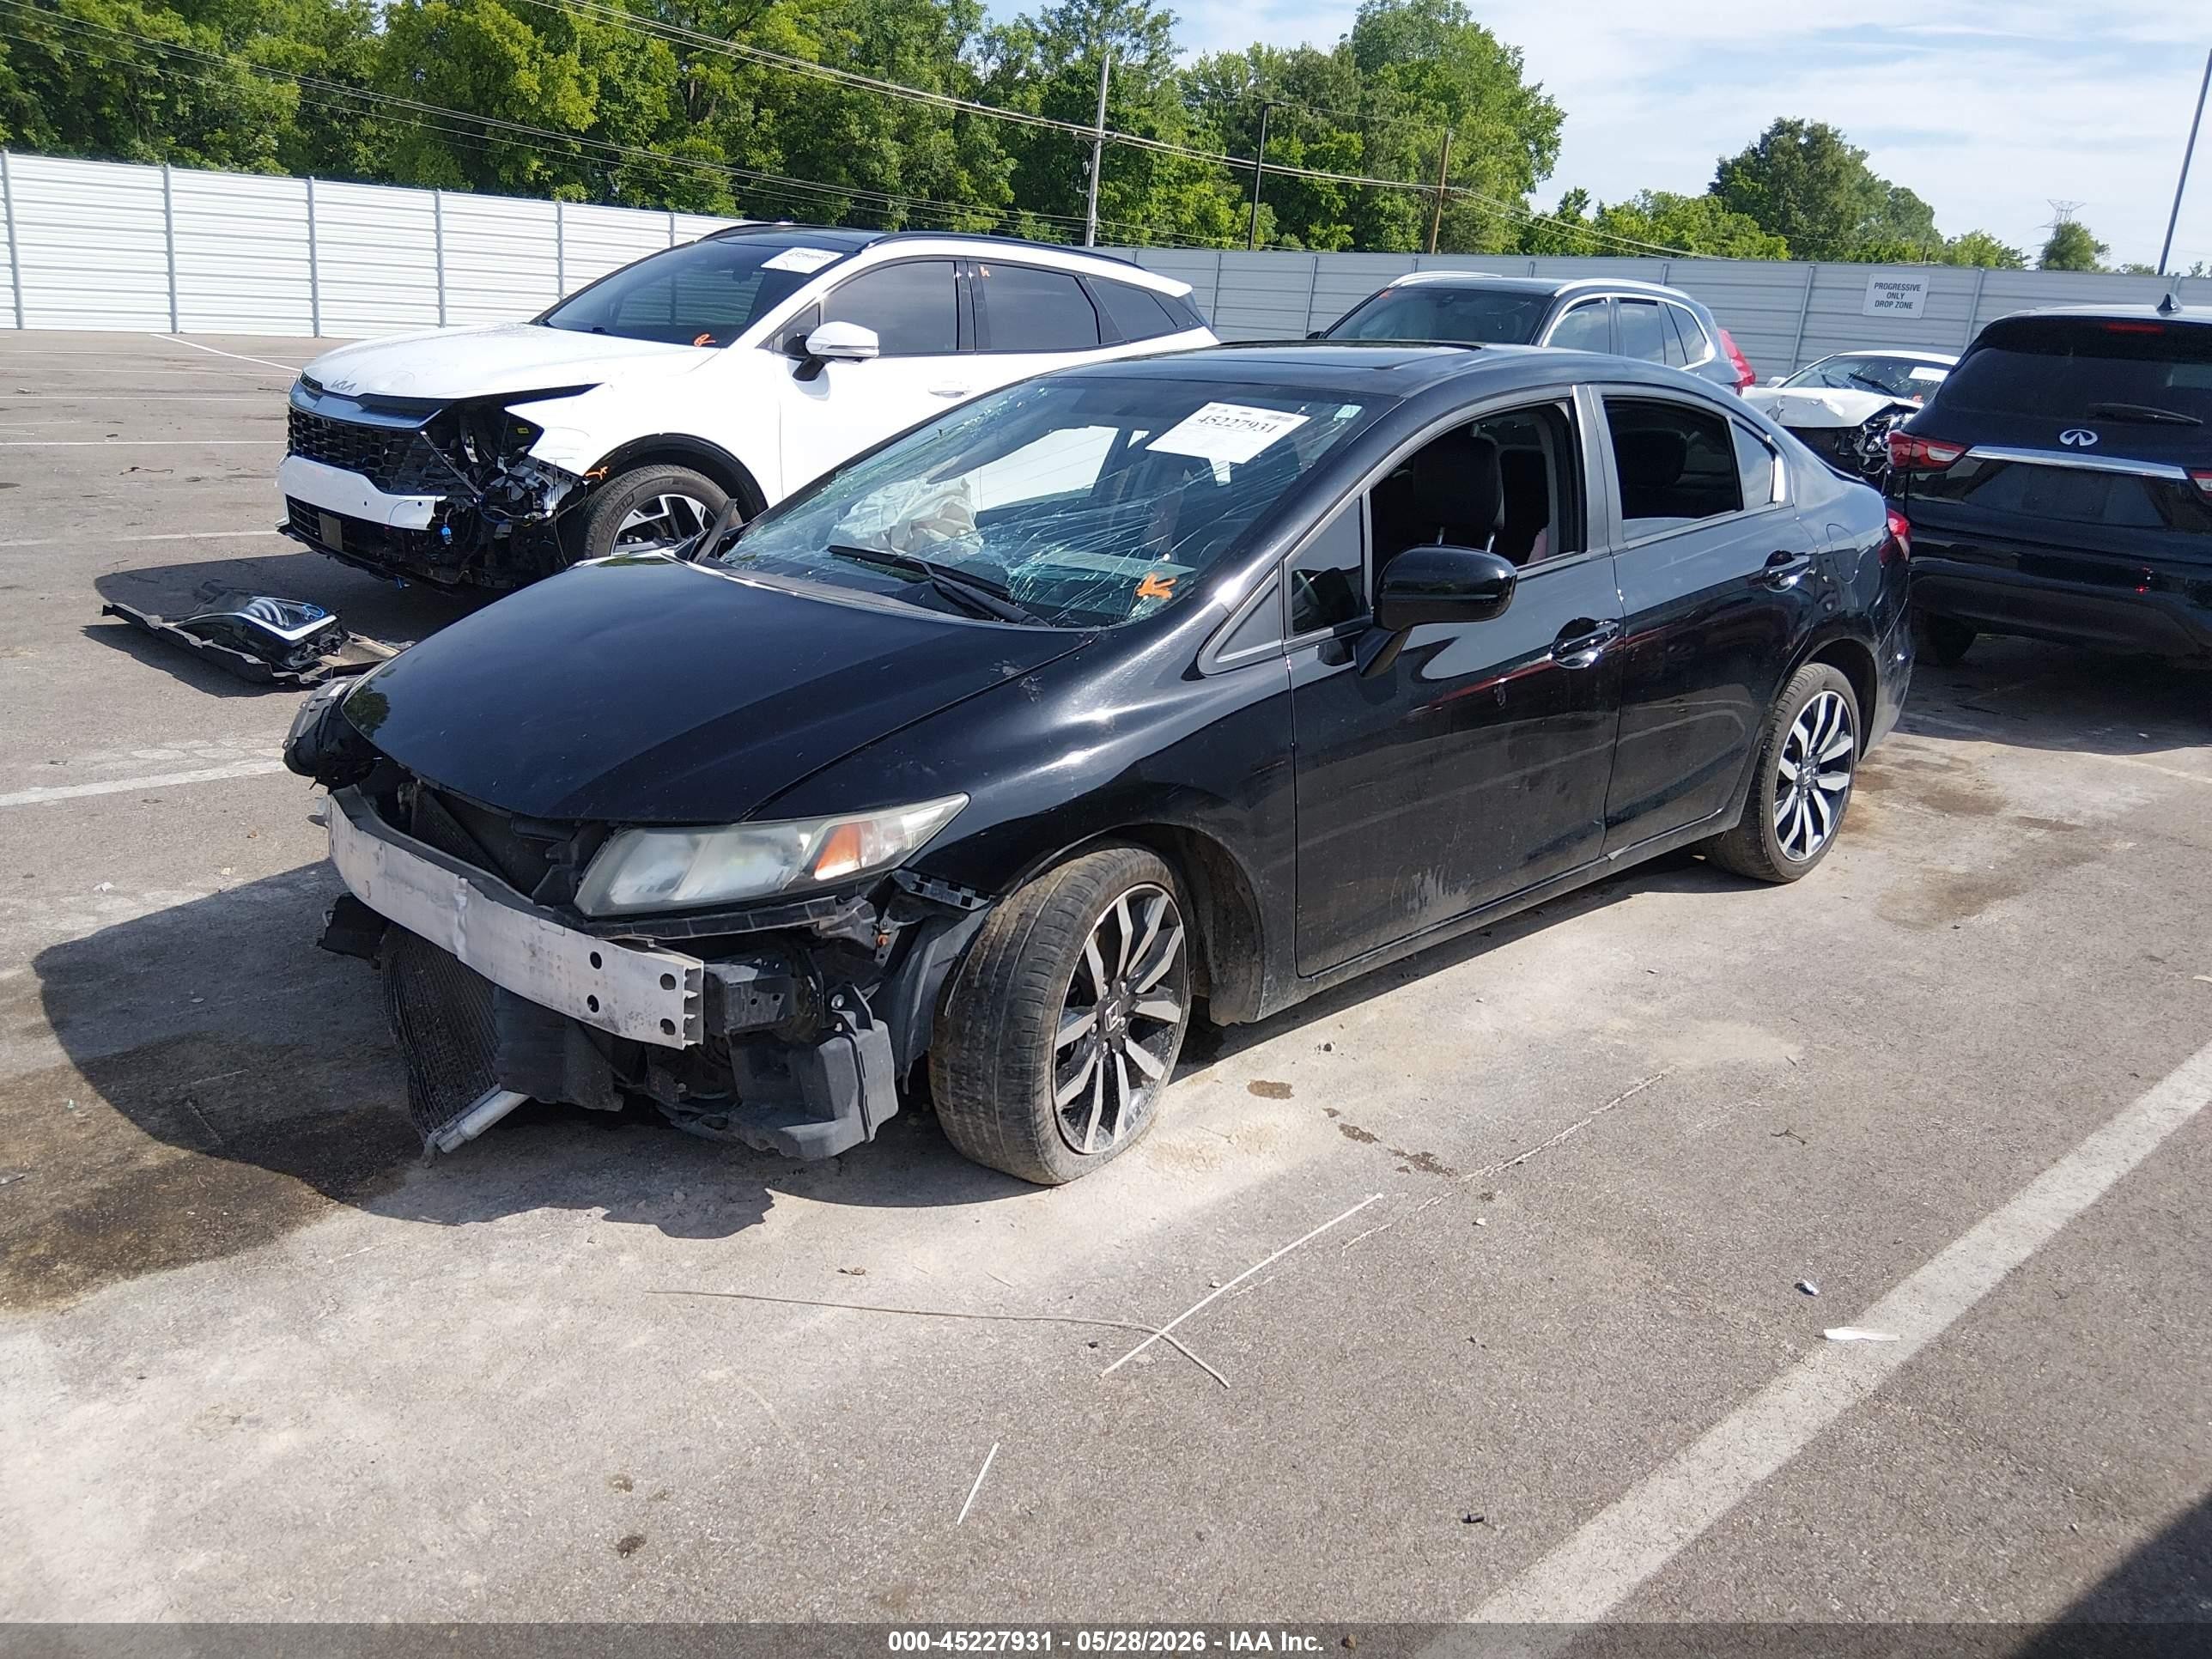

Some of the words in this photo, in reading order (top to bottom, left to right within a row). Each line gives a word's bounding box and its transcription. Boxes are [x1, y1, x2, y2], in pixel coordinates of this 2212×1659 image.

[1874, 282, 1922, 292] PROGRESSIVE
[1875, 300, 1894, 308] DROP
[1196, 414, 1280, 434] 45227931
